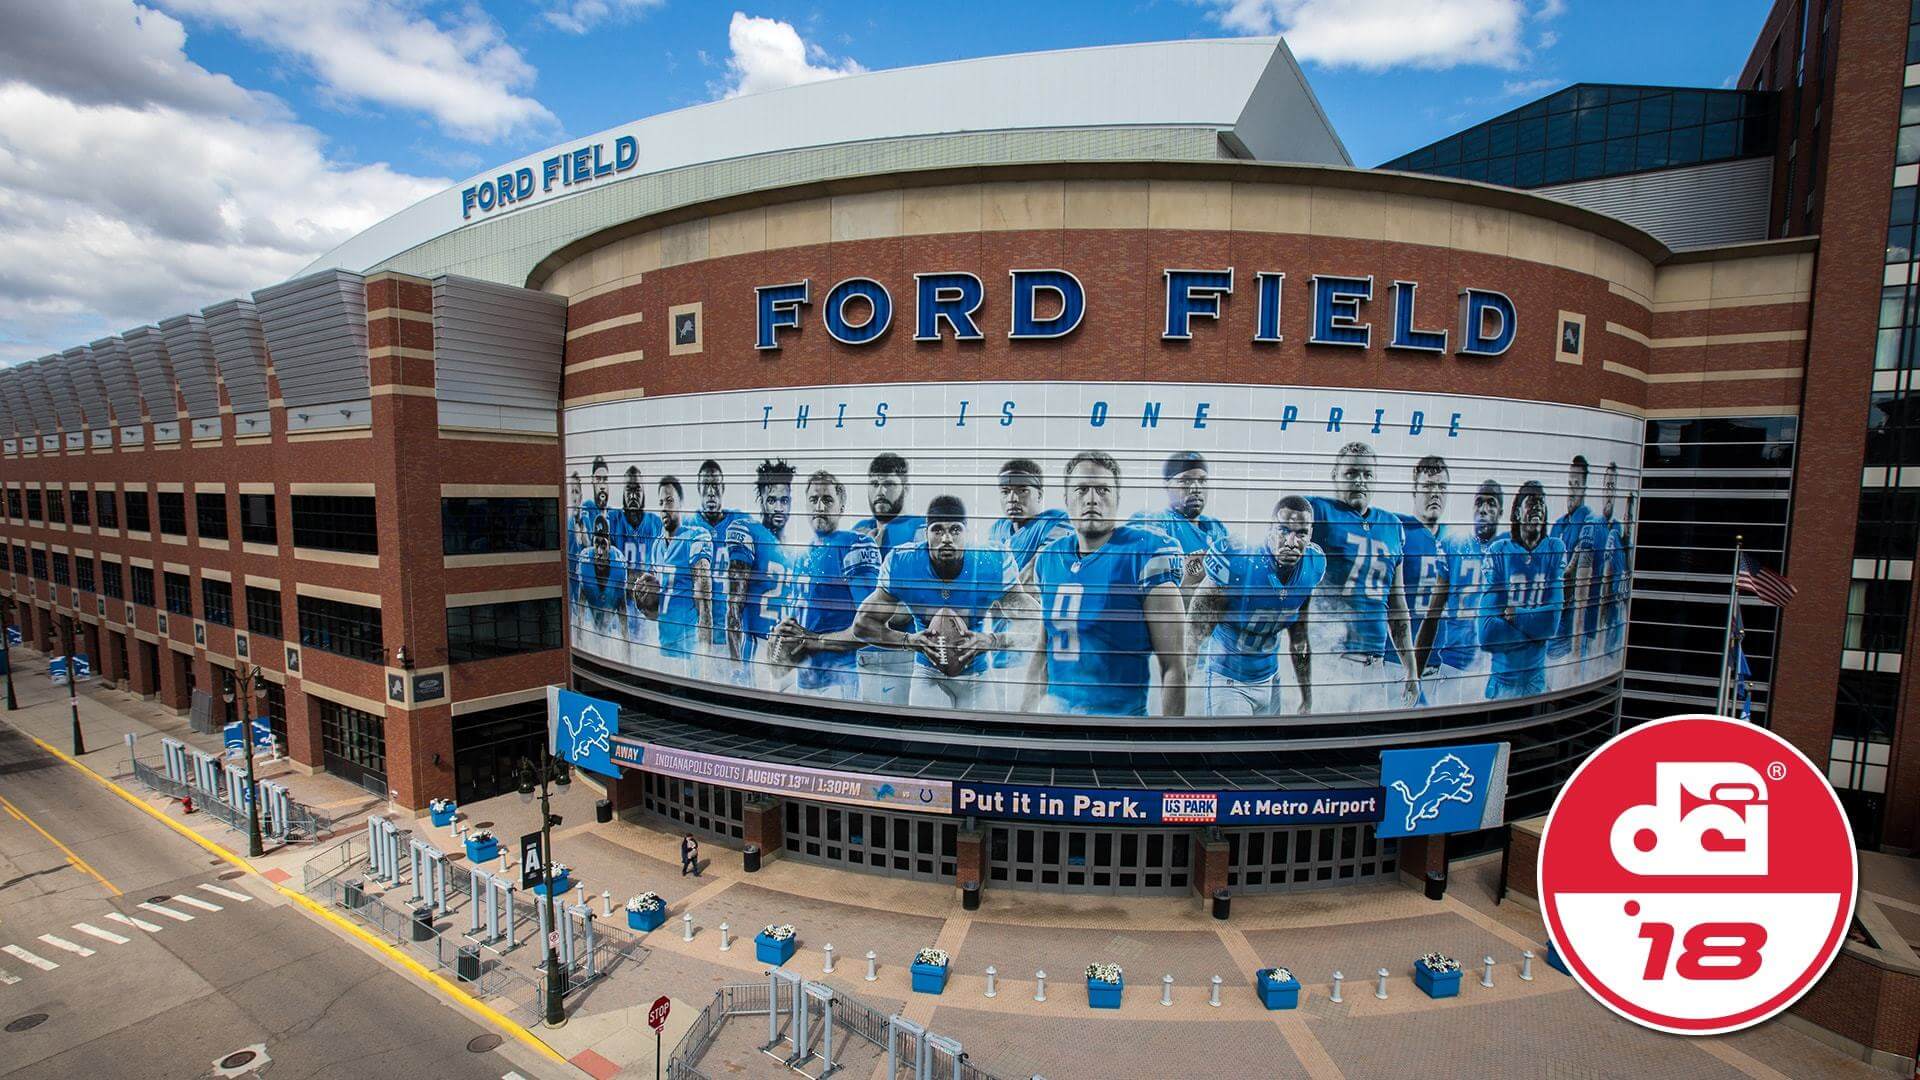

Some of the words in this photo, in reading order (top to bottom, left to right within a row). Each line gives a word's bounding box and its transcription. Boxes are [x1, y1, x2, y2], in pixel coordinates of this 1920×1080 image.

[461, 166, 536, 219] FORD
[542, 134, 640, 192] FIELD
[753, 268, 1087, 350] FORD
[1161, 266, 1519, 357] FIELD
[763, 402, 889, 430] THIS
[956, 400, 1016, 427] IS
[1089, 400, 1211, 430] ONE
[1280, 404, 1462, 438] PRIDE
[1342, 532, 1391, 601] 76
[1050, 582, 1085, 662] 9
[614, 744, 640, 761] AWAY
[655, 752, 713, 777] INDIANAPOLIS
[713, 763, 740, 780] COLTS
[746, 769, 788, 787] AUGUST
[816, 777, 862, 796] 1:30PM
[959, 787, 1004, 813] Put
[1012, 791, 1031, 814] it
[1039, 792, 1064, 816] in
[1073, 794, 1147, 819] Park.
[1165, 799, 1181, 814] US
[1183, 799, 1215, 814] PARK
[1229, 799, 1251, 816] At
[1255, 798, 1309, 816] Metro
[1312, 796, 1376, 816] Airport
[650, 1002, 670, 1023] STOP
